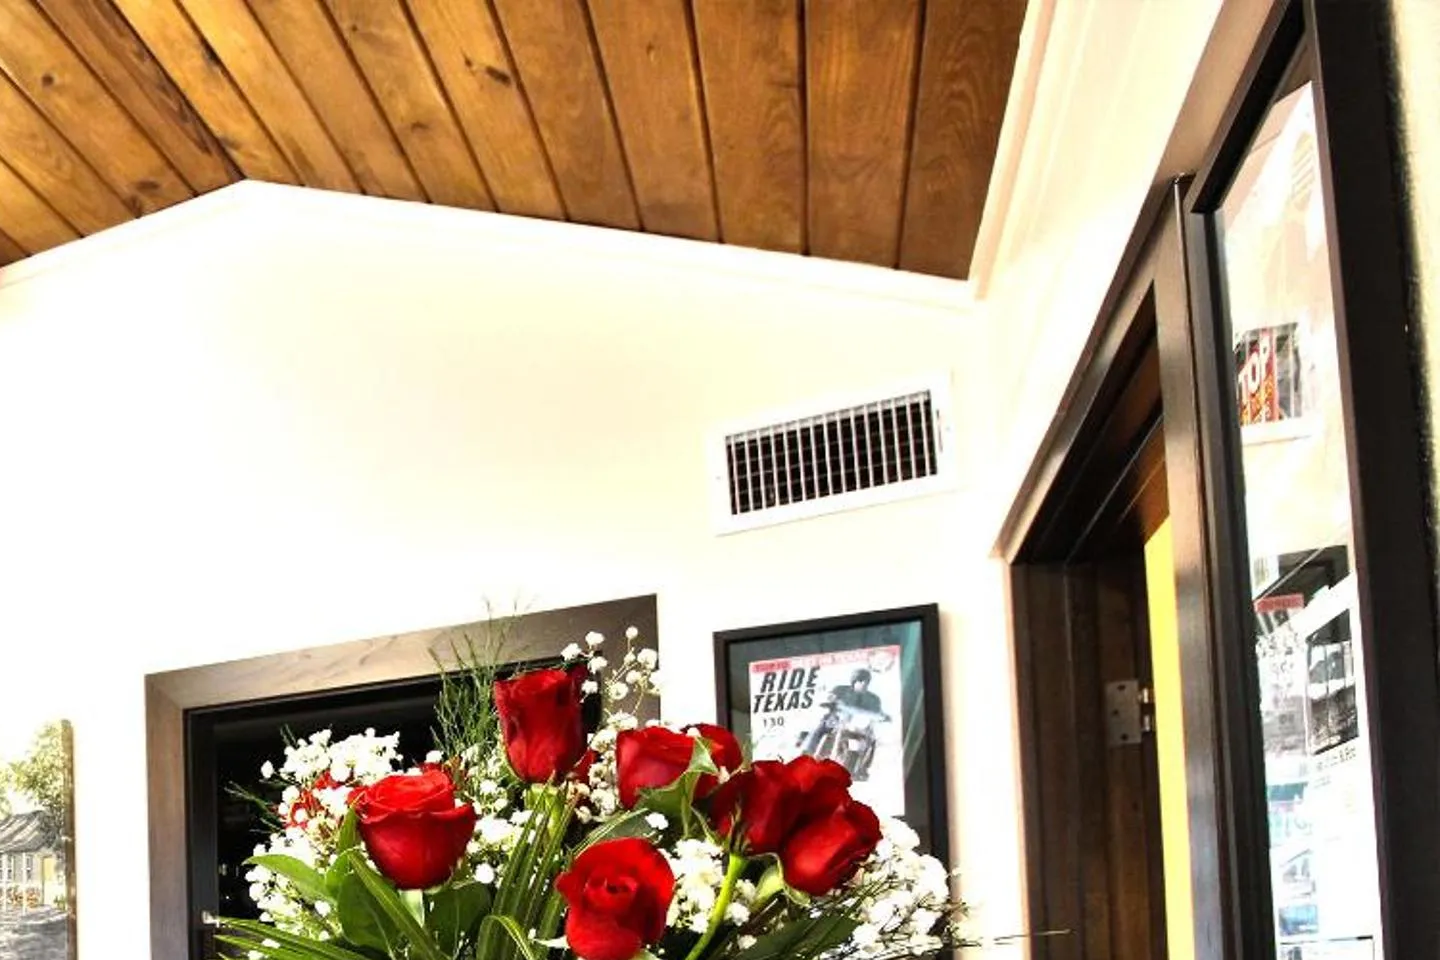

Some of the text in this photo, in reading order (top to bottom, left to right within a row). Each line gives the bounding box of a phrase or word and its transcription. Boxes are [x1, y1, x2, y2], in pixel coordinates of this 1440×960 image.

[760, 665, 820, 694] RIDE
[753, 689, 815, 714] TEXAS
[763, 716, 785, 728] 130
